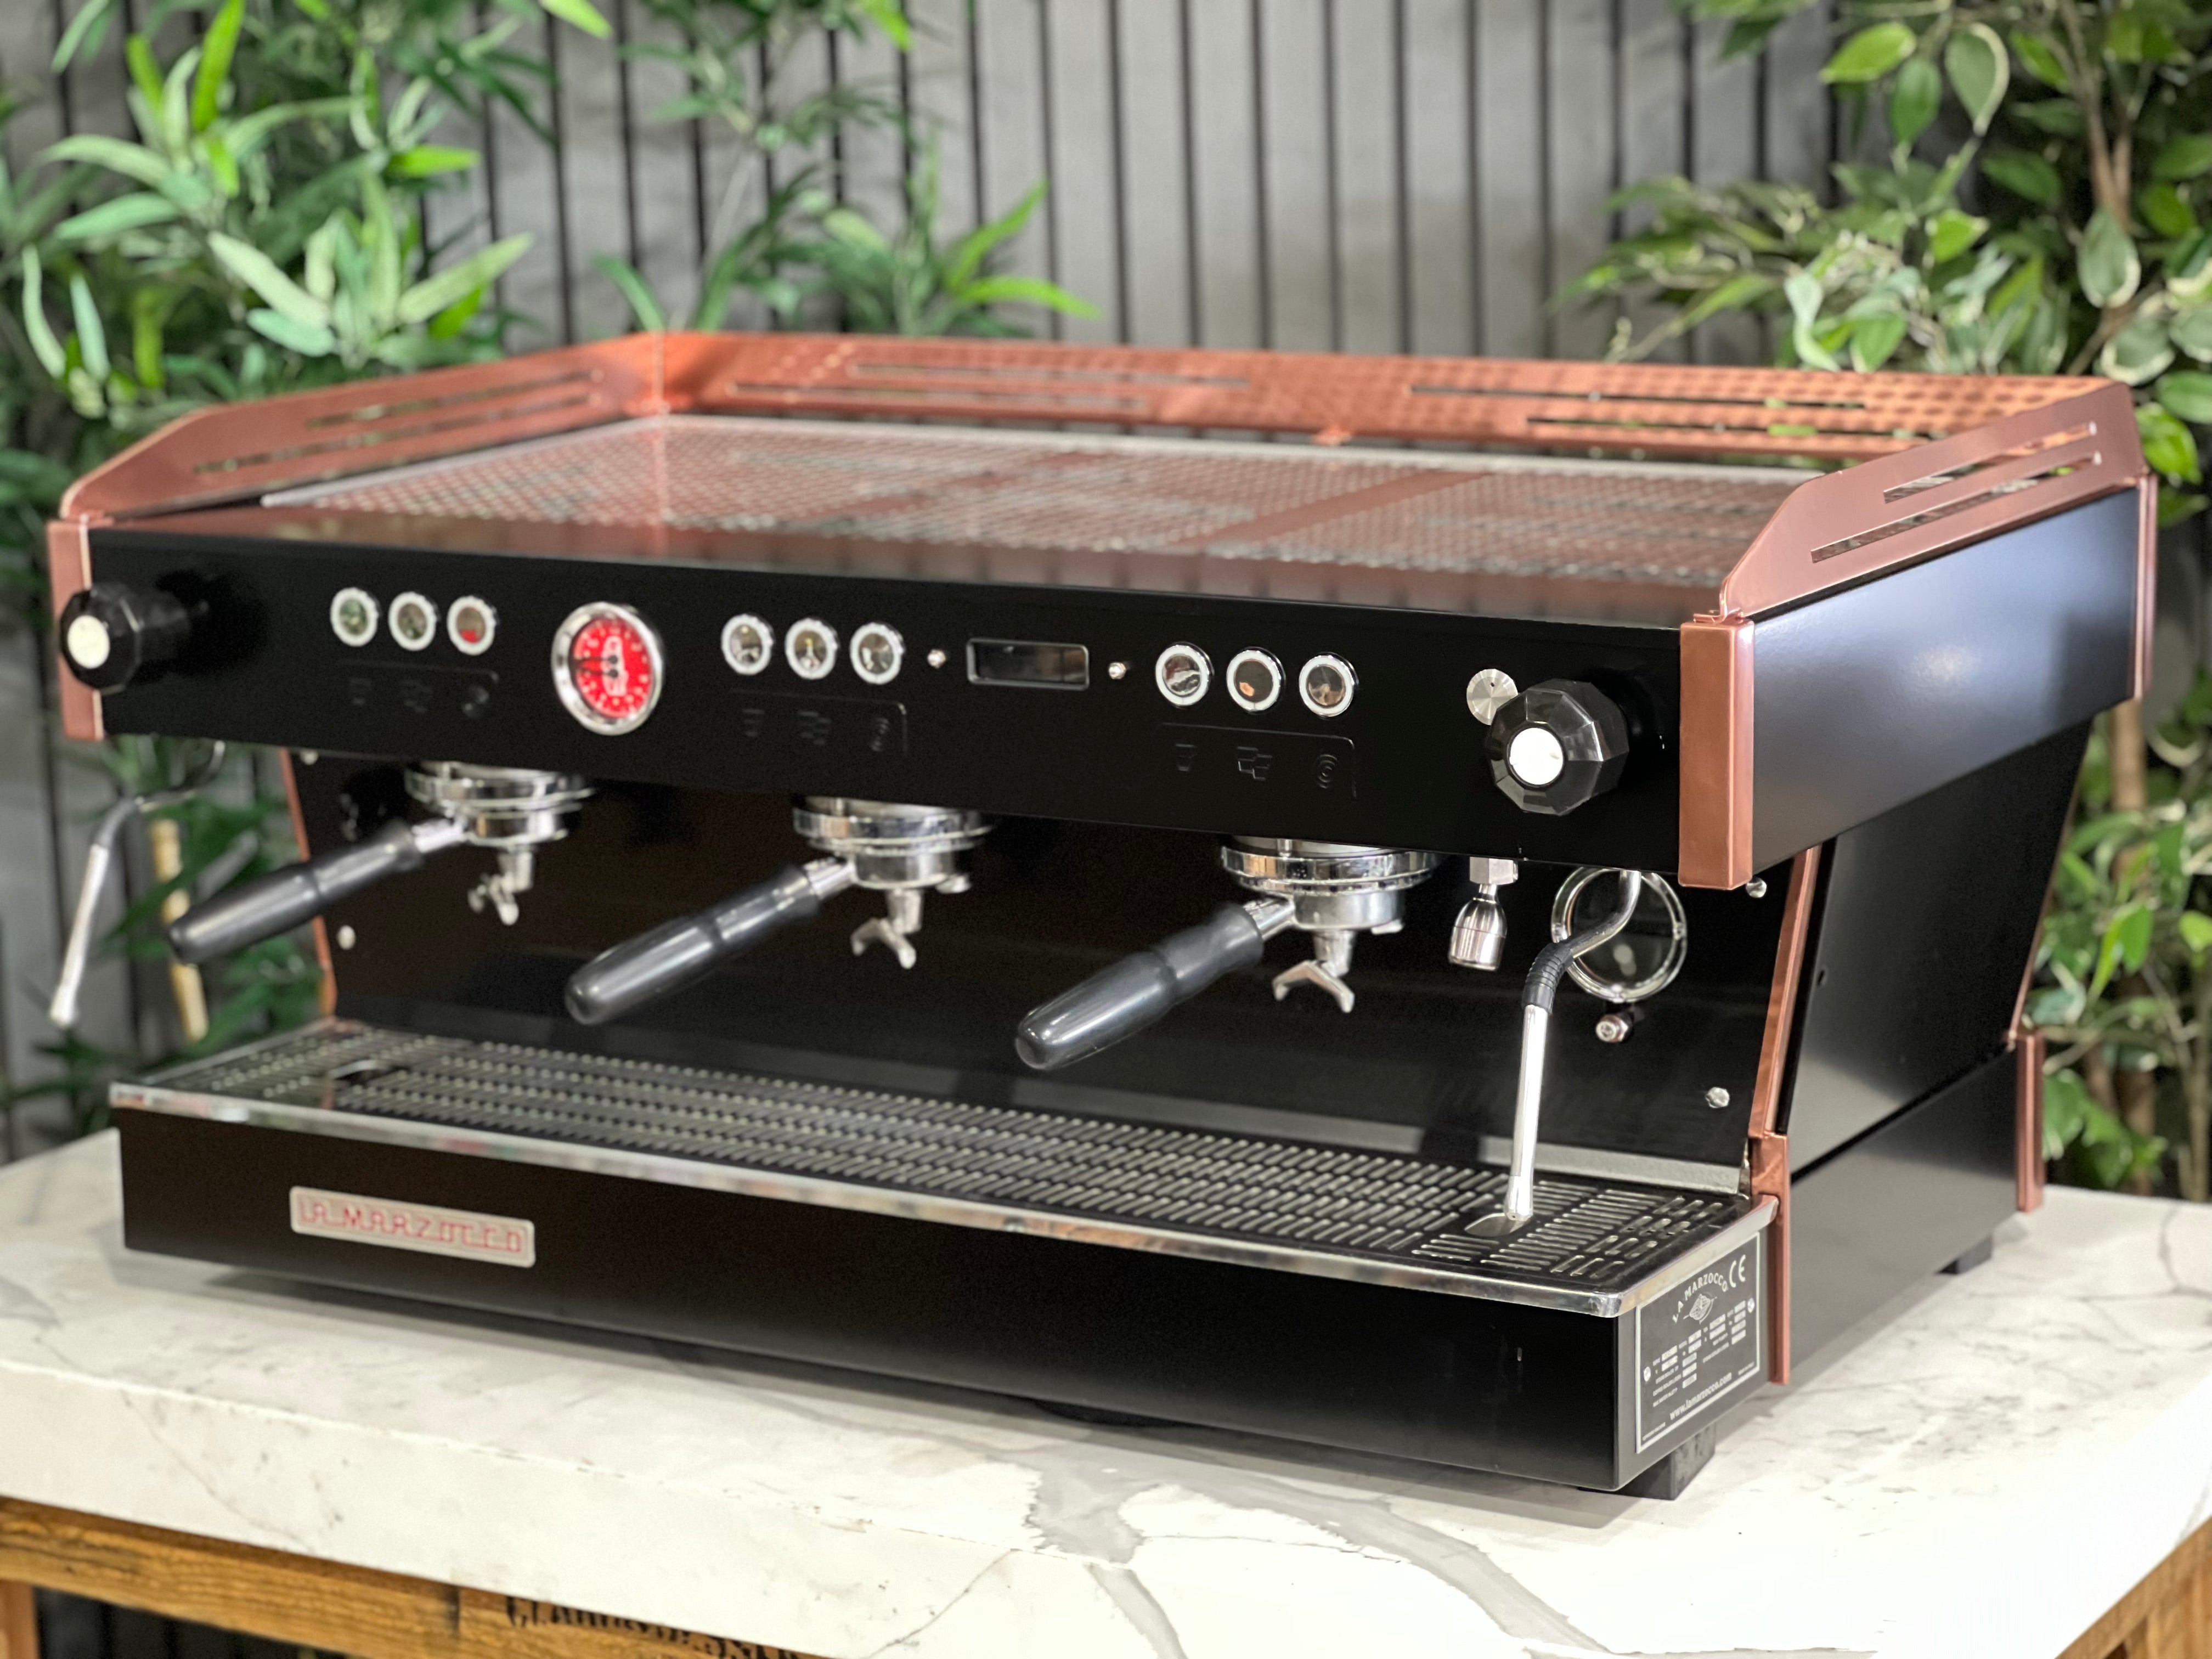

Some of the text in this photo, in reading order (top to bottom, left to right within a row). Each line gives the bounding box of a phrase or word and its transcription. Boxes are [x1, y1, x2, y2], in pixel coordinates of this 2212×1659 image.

[1672, 1272, 1728, 1324] LA MARZOCCO
[1669, 1372, 1733, 1420] www.lamarzocco.com
